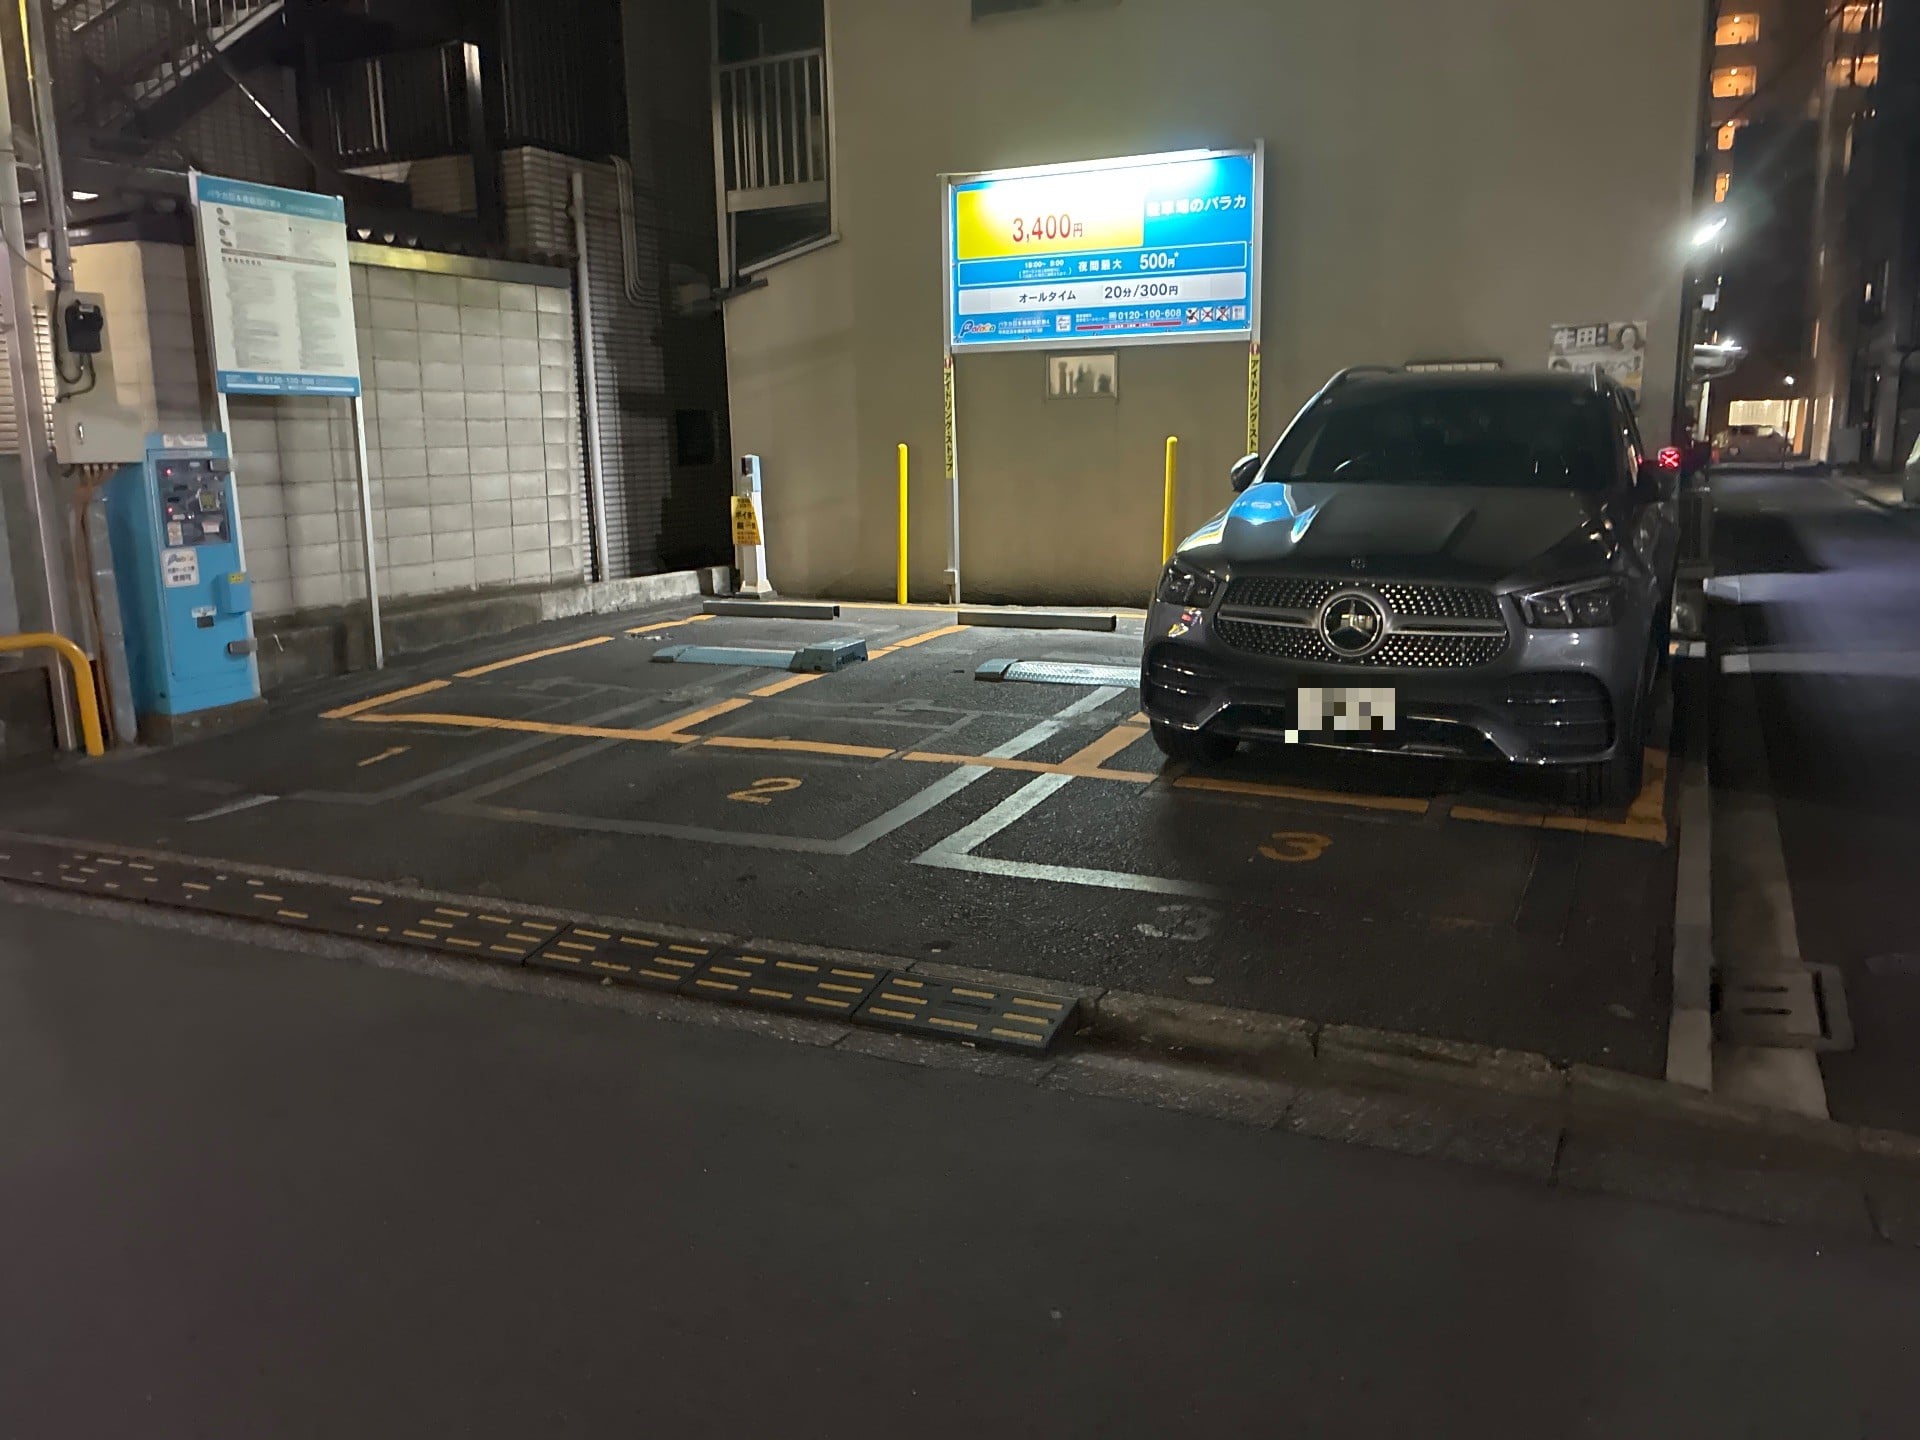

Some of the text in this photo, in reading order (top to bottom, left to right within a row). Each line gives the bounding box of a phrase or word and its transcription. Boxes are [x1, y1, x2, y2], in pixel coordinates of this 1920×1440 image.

[1012, 213, 1083, 243] 3,400円
[1078, 258, 1123, 273] 夜間最大
[1019, 283, 1179, 304] オールタイム 20分/300円
[1117, 309, 1182, 321] 0120-100-608
[726, 777, 803, 805] 2
[1258, 831, 1334, 862] 3
